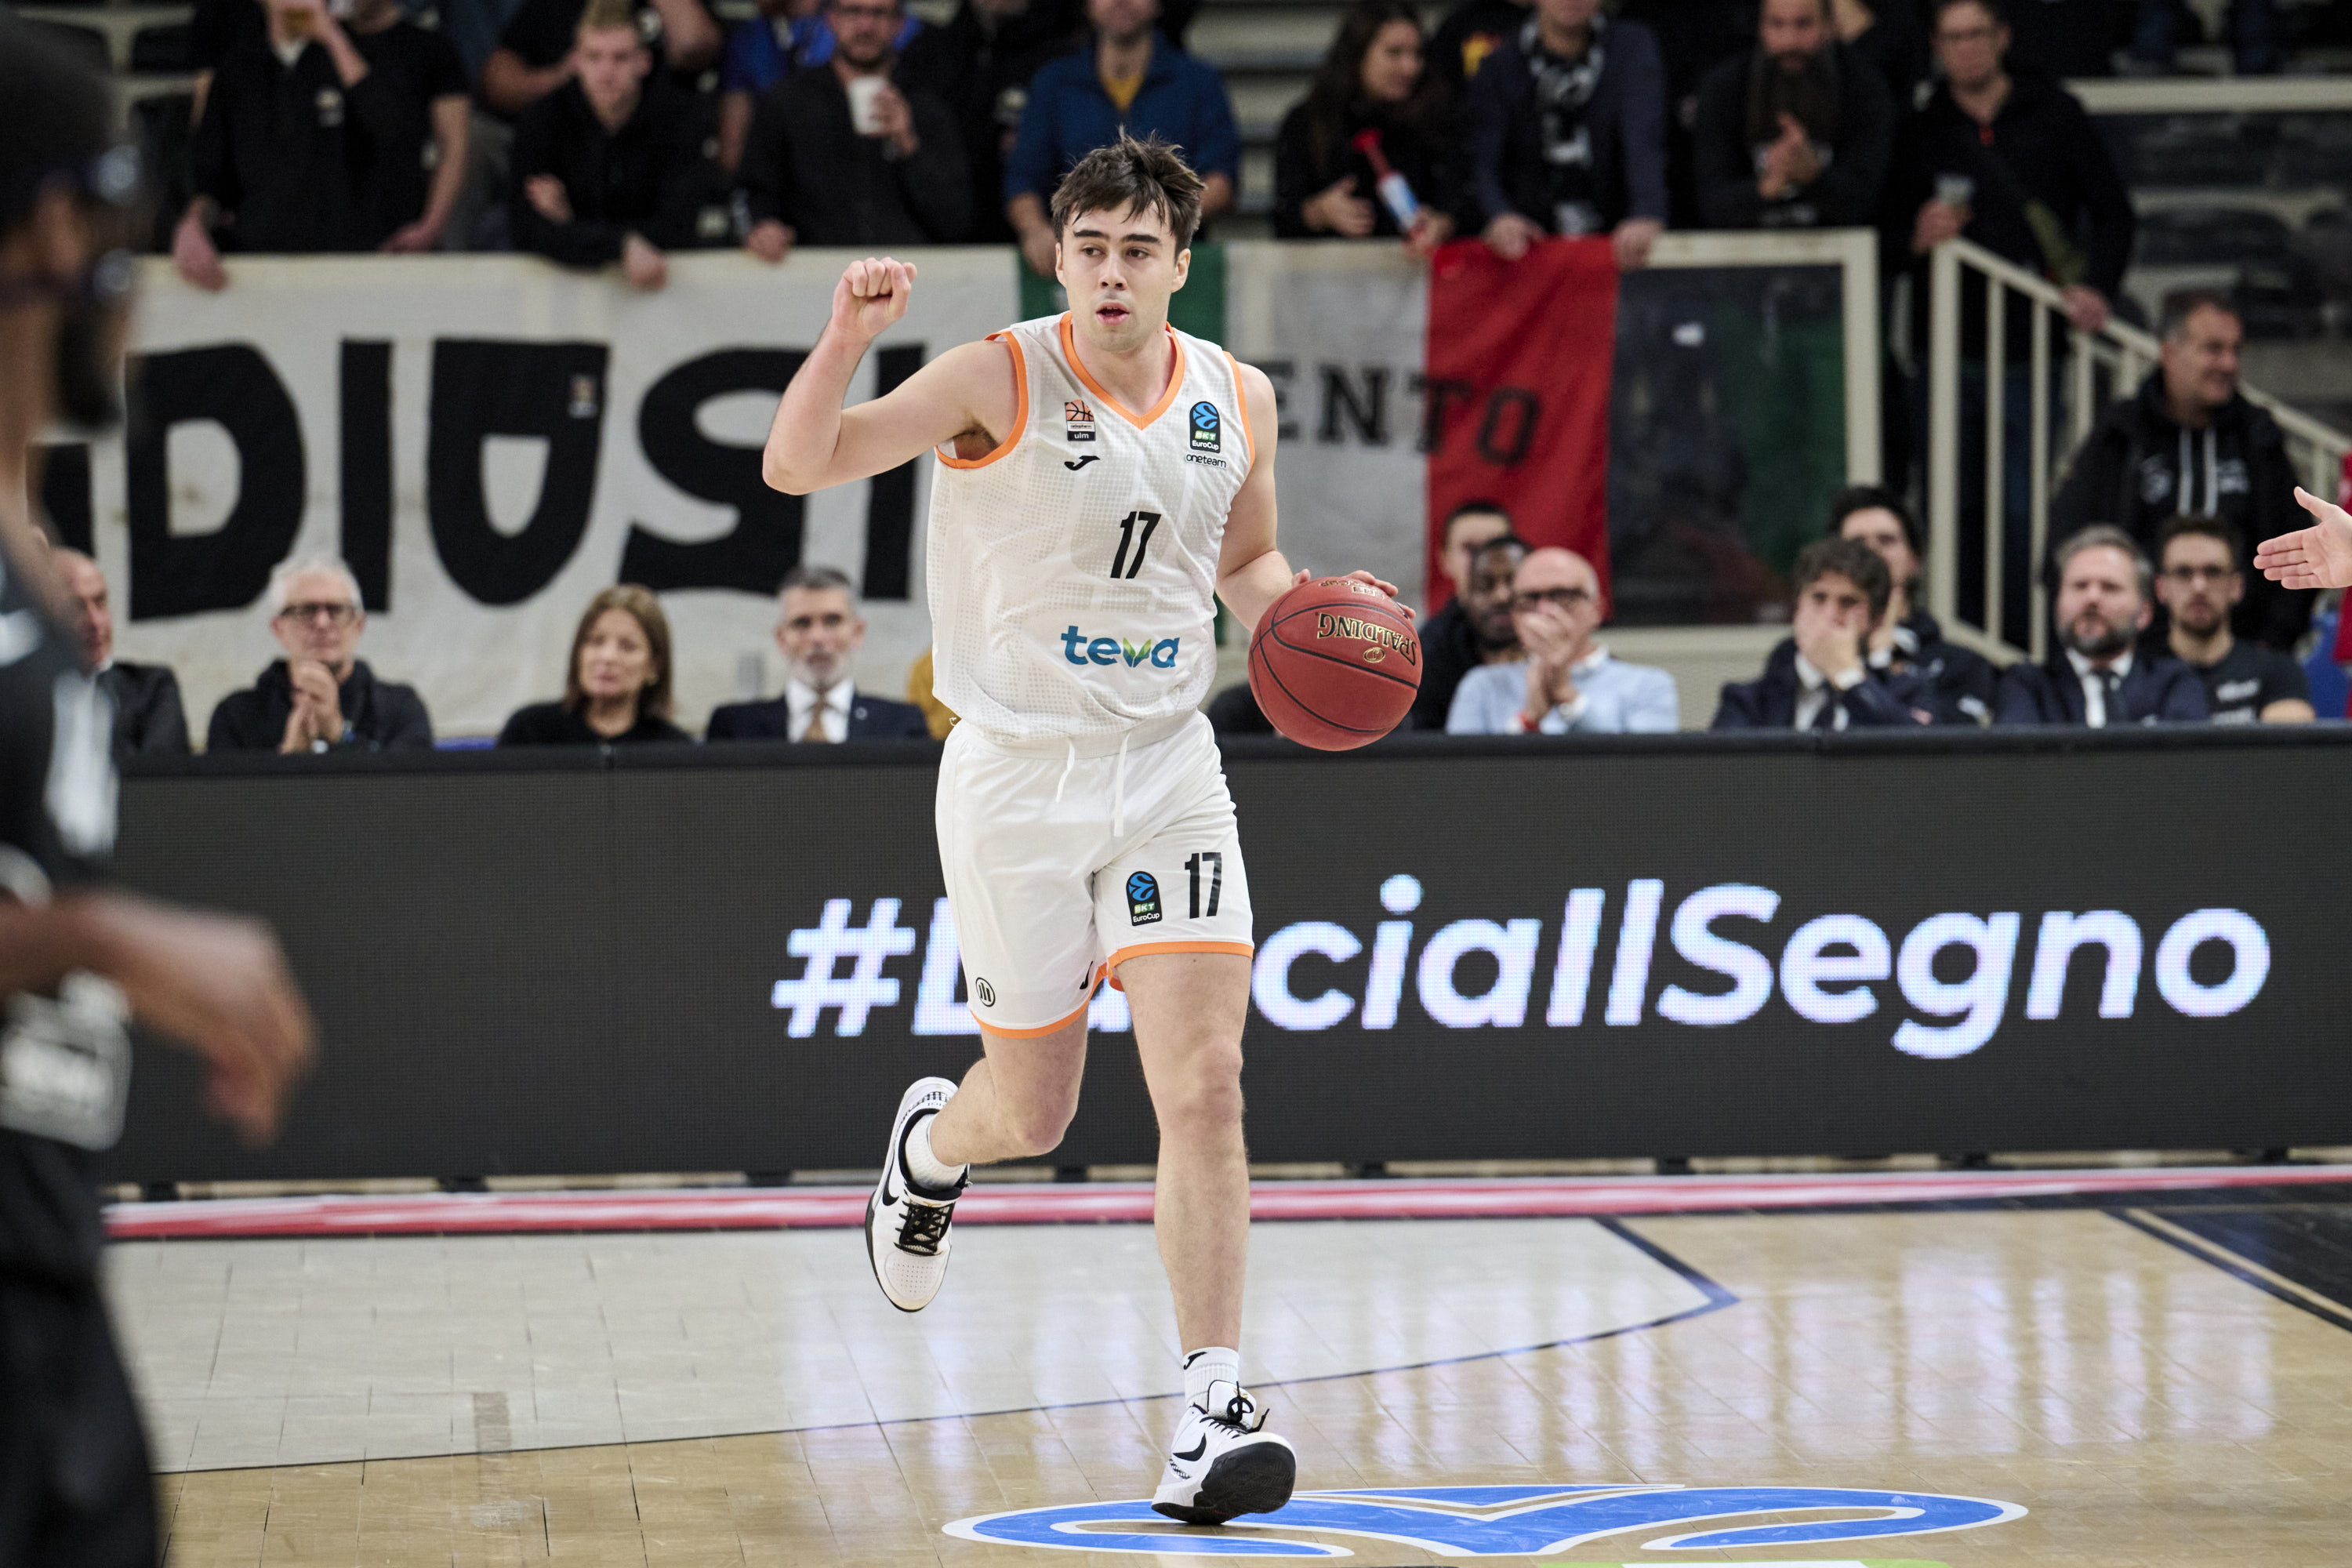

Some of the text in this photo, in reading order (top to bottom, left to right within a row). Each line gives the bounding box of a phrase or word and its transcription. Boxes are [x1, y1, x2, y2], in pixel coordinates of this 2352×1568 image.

[1254, 358, 1541, 466] ENTO
[1192, 440, 1219, 451] EuroCup
[1110, 511, 1162, 579] 17
[1061, 625, 1180, 668] teva
[1317, 612, 1417, 666] SPALDING
[1185, 852, 1222, 919] 17
[1133, 913, 1160, 923] EuroCup
